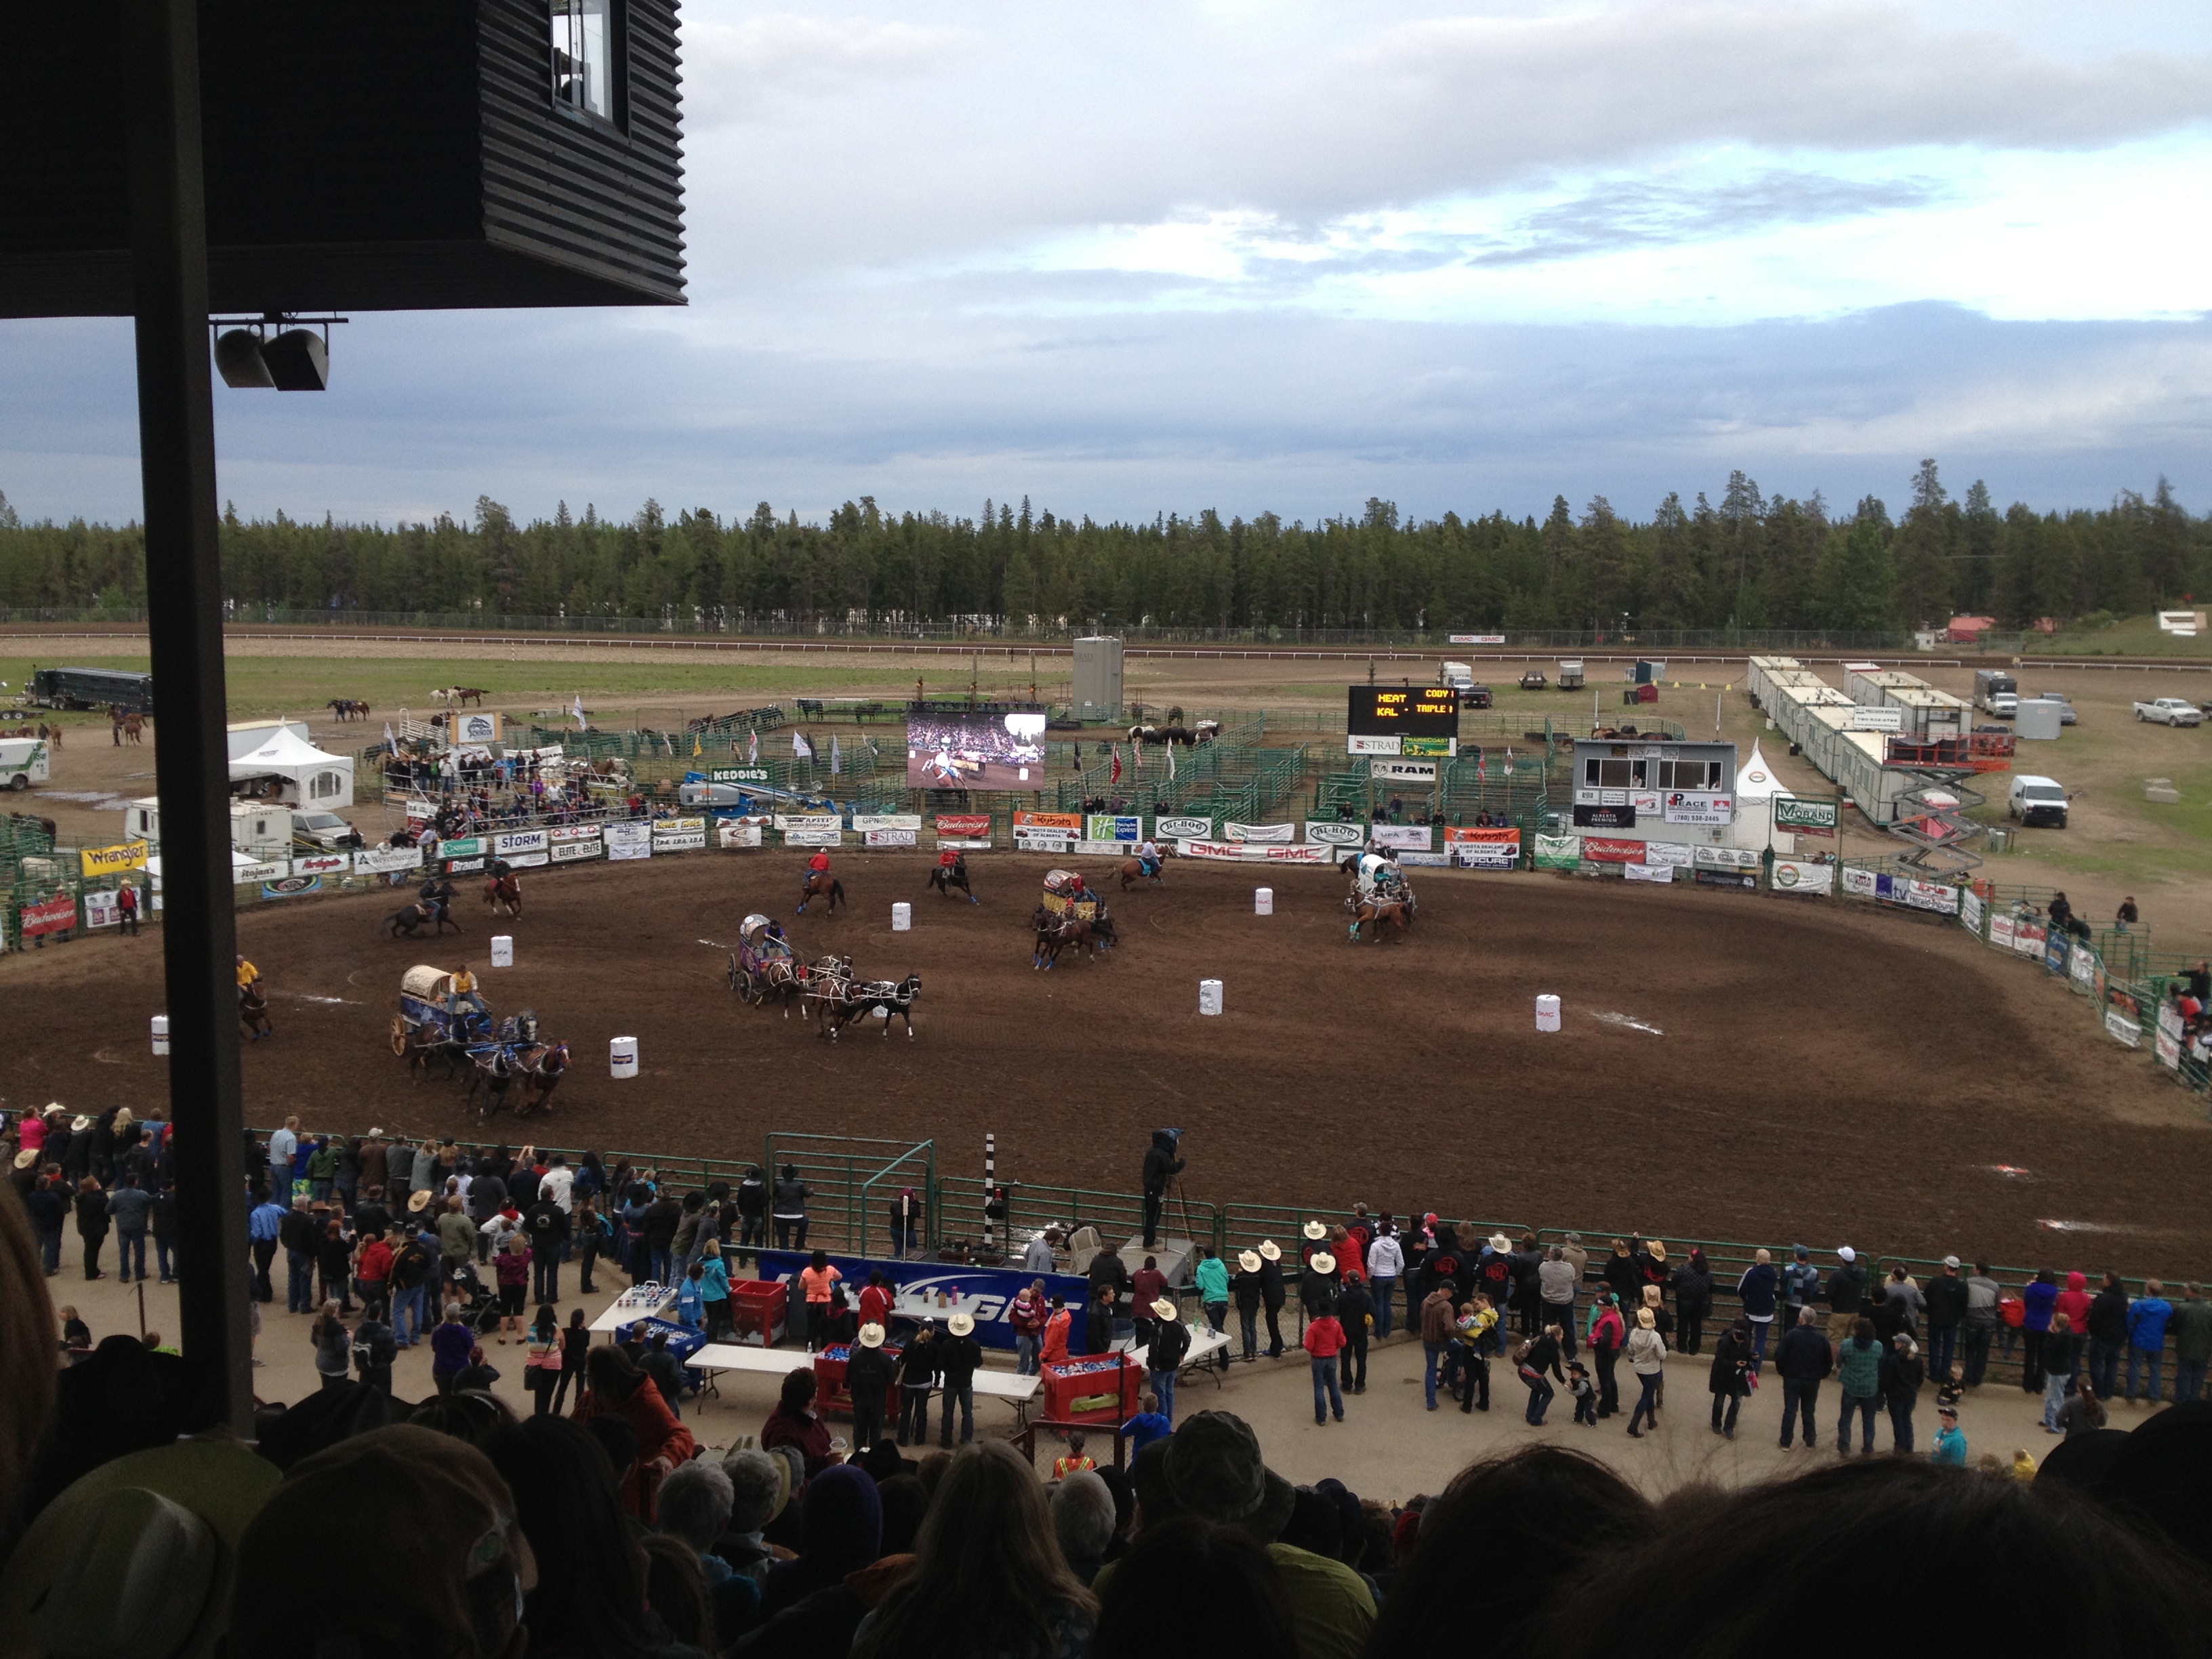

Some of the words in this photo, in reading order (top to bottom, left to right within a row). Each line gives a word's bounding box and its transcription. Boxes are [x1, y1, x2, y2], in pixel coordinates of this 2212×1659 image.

[1378, 693, 1407, 703] HEAT
[1425, 689, 1449, 698] CODY
[1376, 708, 1399, 717] KAL
[1416, 704, 1446, 714] TRIPLE
[1365, 739, 1400, 750] STRAD
[714, 769, 769, 781] KEDDIE'S
[1391, 765, 1434, 775] RAM
[1779, 803, 1833, 821] MORAND
[937, 819, 989, 830] Budweiser
[1038, 815, 1071, 825] Kubota
[1166, 820, 1203, 831] HI-HOG
[880, 832, 914, 841] STRAD
[1315, 826, 1355, 838] HI-HOG
[1470, 832, 1509, 841] Kubota
[559, 846, 577, 857] ELITE
[583, 842, 600, 853] ELITE
[1190, 843, 1243, 857] GMC
[1267, 847, 1322, 860] GMC
[1585, 842, 1645, 855] Budweiser
[88, 845, 144, 867] Wrangler
[22, 909, 75, 928] Budweiser
